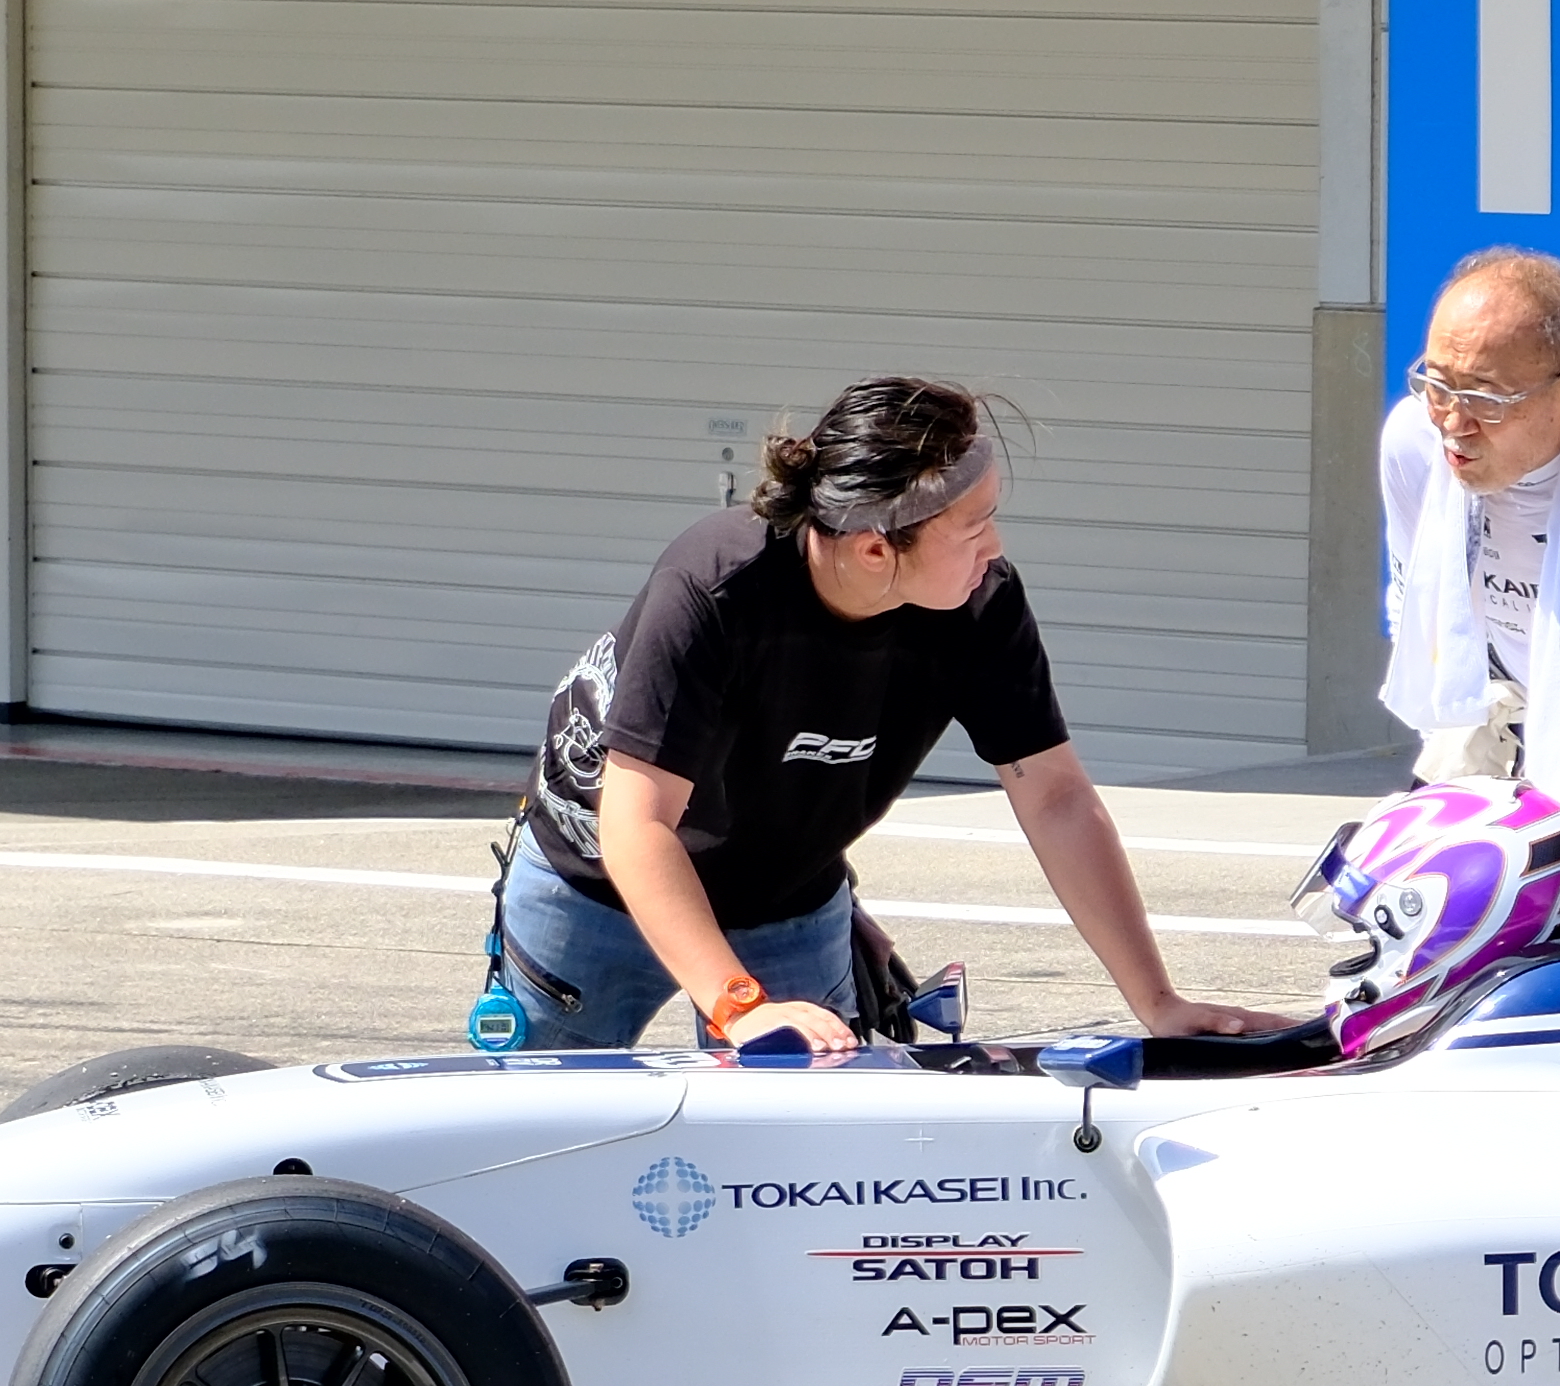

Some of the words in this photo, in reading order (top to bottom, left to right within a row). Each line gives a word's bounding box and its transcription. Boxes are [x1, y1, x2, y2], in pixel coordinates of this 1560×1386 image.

[1021, 1176, 1088, 1201] Inc.
[862, 1234, 1030, 1249] DISPLAY
[852, 1257, 1040, 1281] SATOH
[881, 1303, 1088, 1346] A-pex
[961, 1335, 1029, 1346] MOTOR
[1033, 1335, 1097, 1345] SPORT
